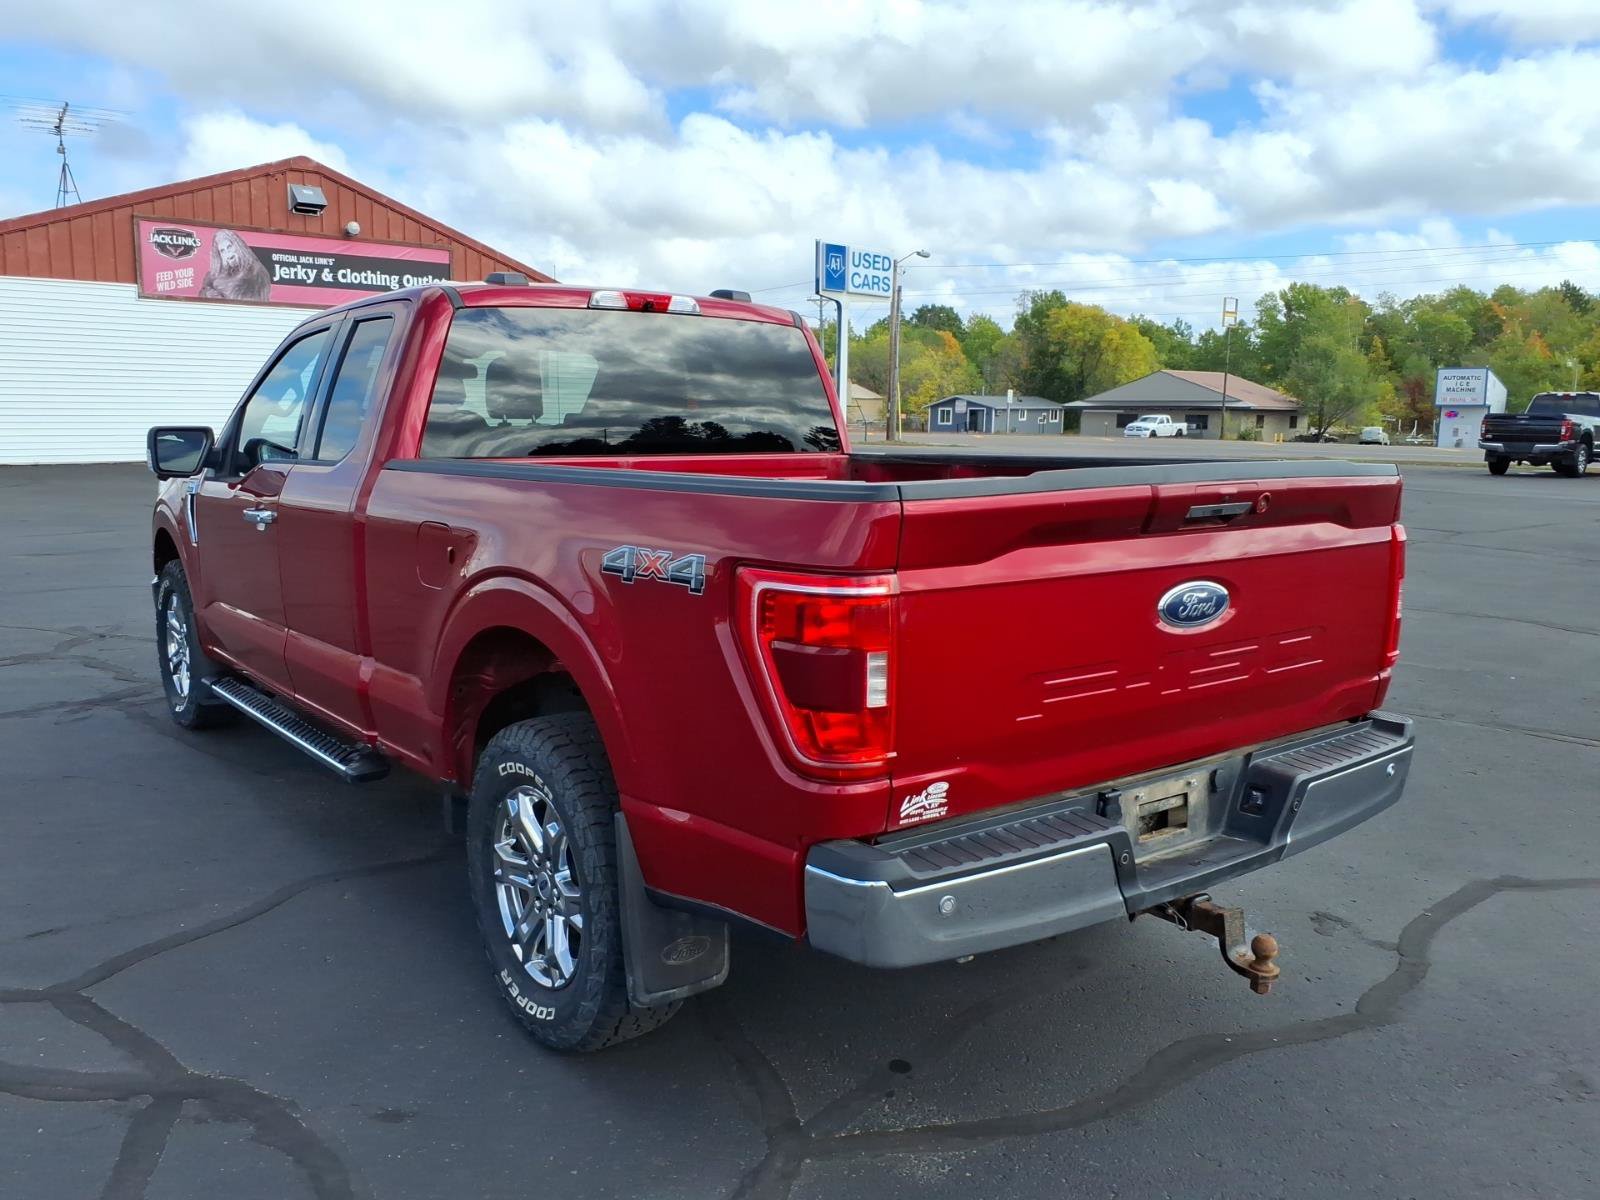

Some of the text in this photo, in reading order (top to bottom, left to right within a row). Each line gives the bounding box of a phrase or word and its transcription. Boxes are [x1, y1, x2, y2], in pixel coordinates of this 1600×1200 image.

[148, 232, 173, 244] JACK
[272, 253, 298, 263] OFFICIAL
[299, 255, 314, 264] JACK
[852, 251, 892, 272] USED
[156, 267, 194, 281] FEED YOUR
[156, 277, 194, 291] WILD SIDE
[273, 264, 317, 284] Jerky
[321, 268, 334, 282] &
[337, 269, 400, 290] Clothing
[851, 272, 891, 293] CARS
[1179, 591, 1217, 618] Ford
[498, 761, 553, 801] COOPER
[501, 968, 555, 1020] COOPER
